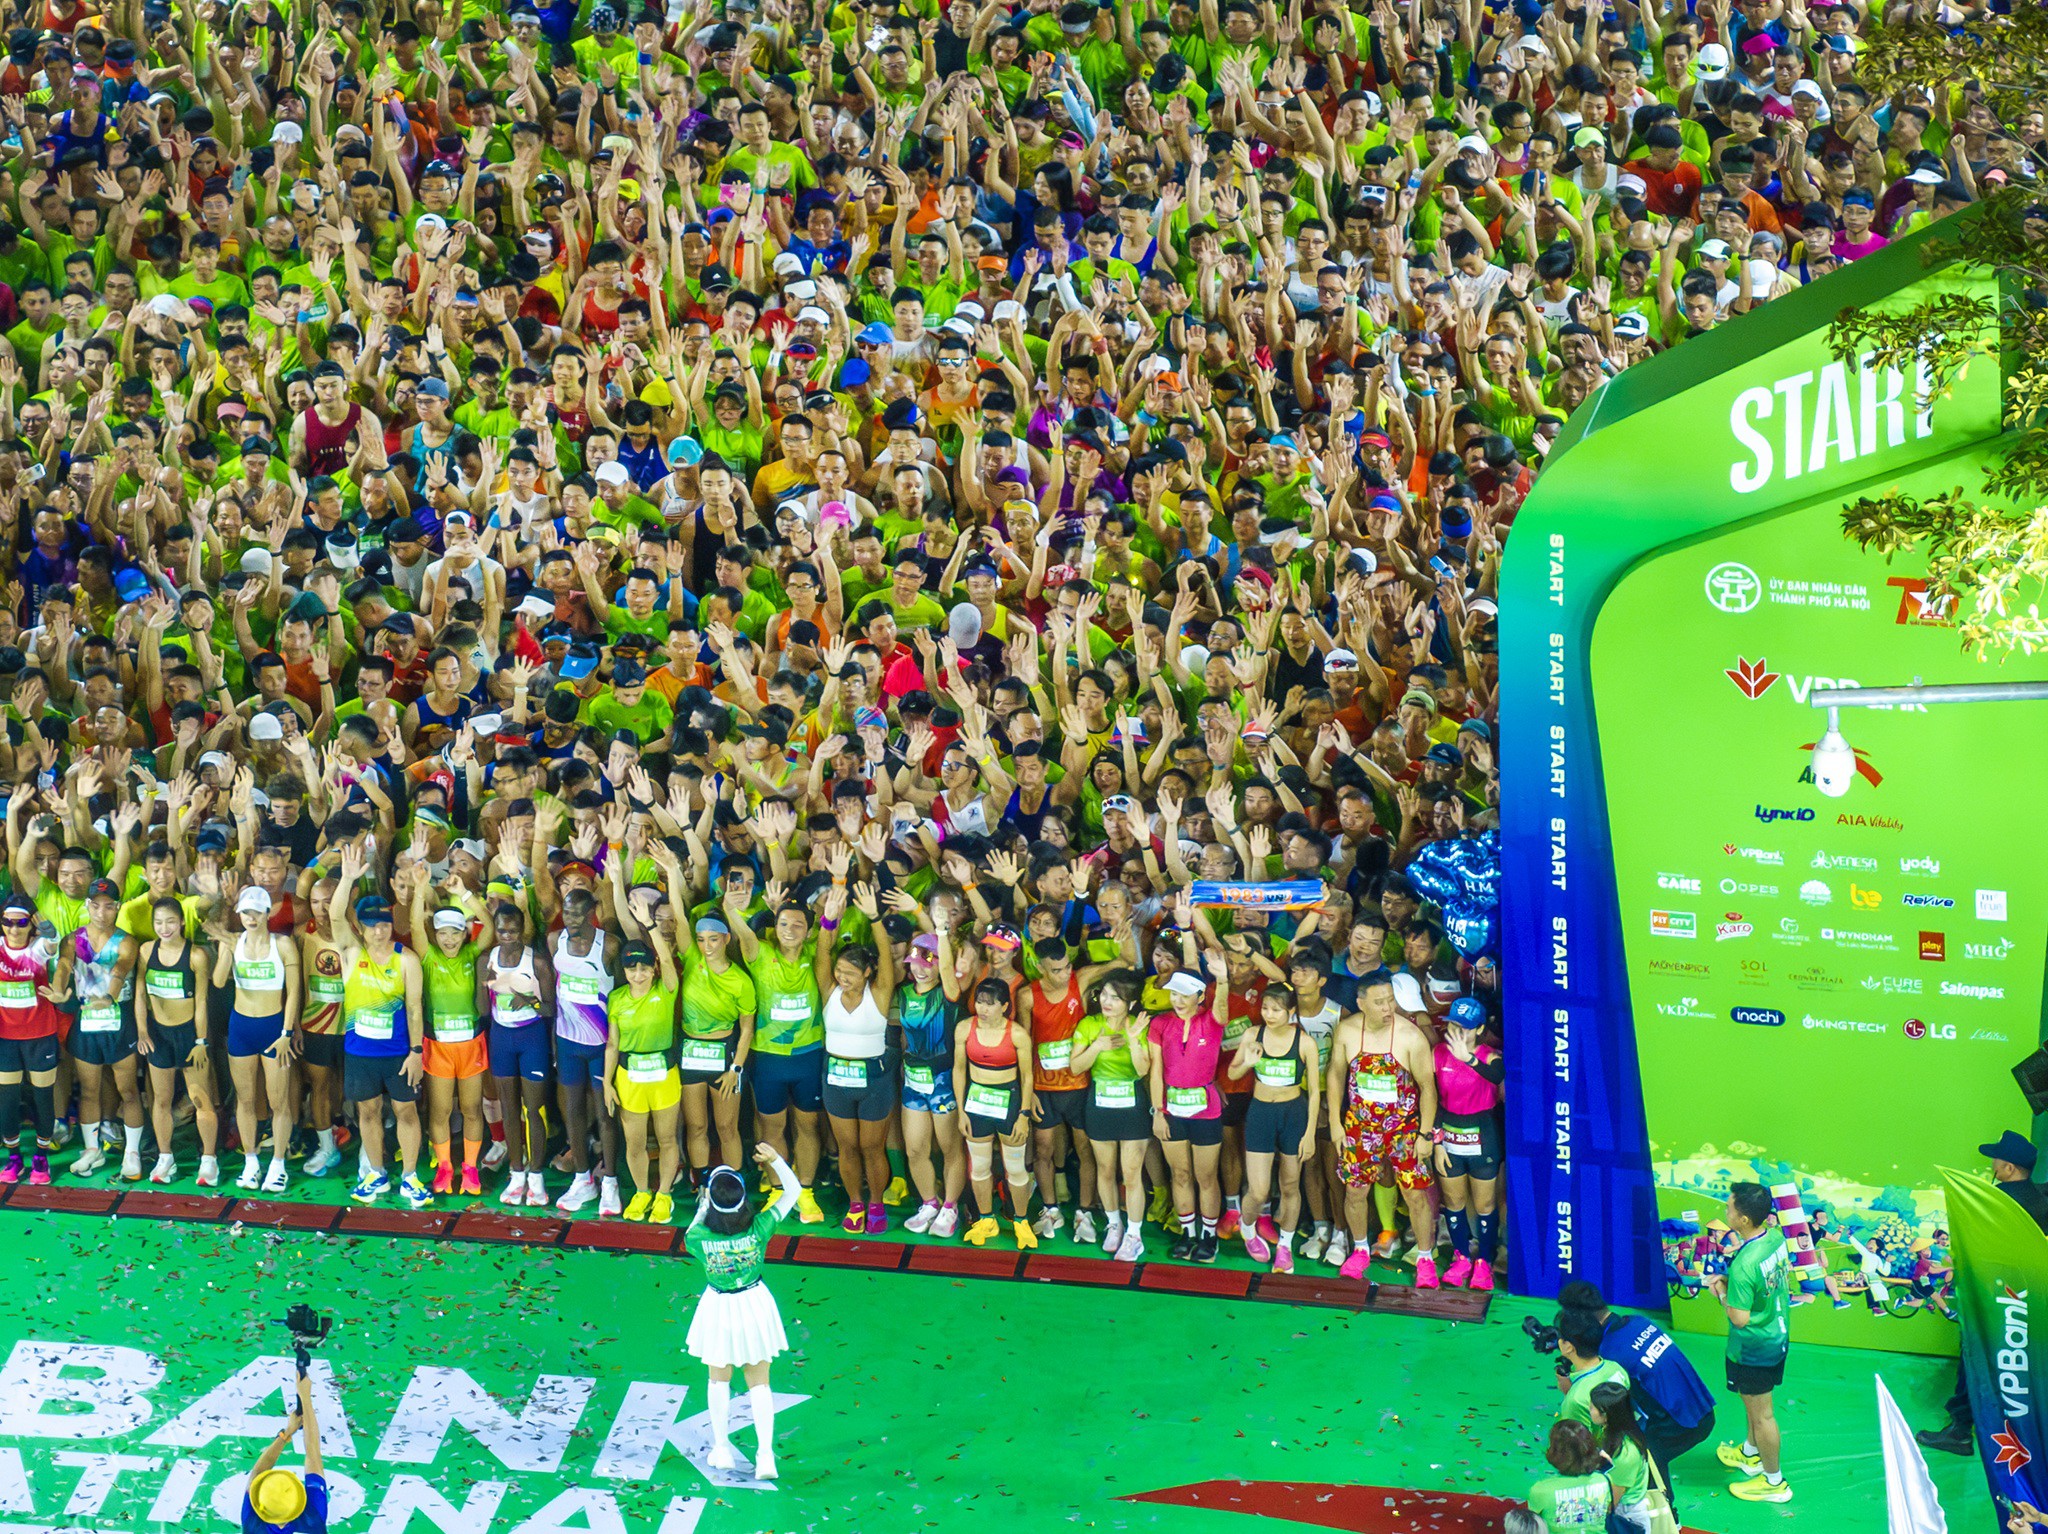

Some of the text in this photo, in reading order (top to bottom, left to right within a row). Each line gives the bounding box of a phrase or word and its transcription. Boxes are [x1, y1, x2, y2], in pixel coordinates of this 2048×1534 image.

[1550, 534, 1564, 606] START
[1550, 633, 1565, 705] START
[1550, 726, 1565, 798] START
[1837, 813, 1904, 832] AIA Vitality
[1551, 818, 1566, 890] START
[1900, 856, 1940, 873] yody
[1657, 876, 1701, 891] CAKE
[1219, 887, 1265, 902] 1983
[1850, 883, 1883, 908] be
[1446, 915, 1468, 935] HM
[1836, 930, 1893, 942] WYNDHAM
[1553, 917, 1569, 989] START
[1740, 959, 1769, 972] SOL
[1882, 976, 1923, 989] CURE
[1939, 981, 2006, 1000] Salonpas
[1736, 1007, 1780, 1024] inochi
[1815, 1018, 1886, 1033] KINGTECH
[1930, 1022, 1957, 1040] LG
[1554, 1009, 1570, 1082] START
[1555, 1102, 1571, 1174] START
[1557, 1201, 1572, 1273] START
[1998, 1288, 2029, 1418] VPBank
